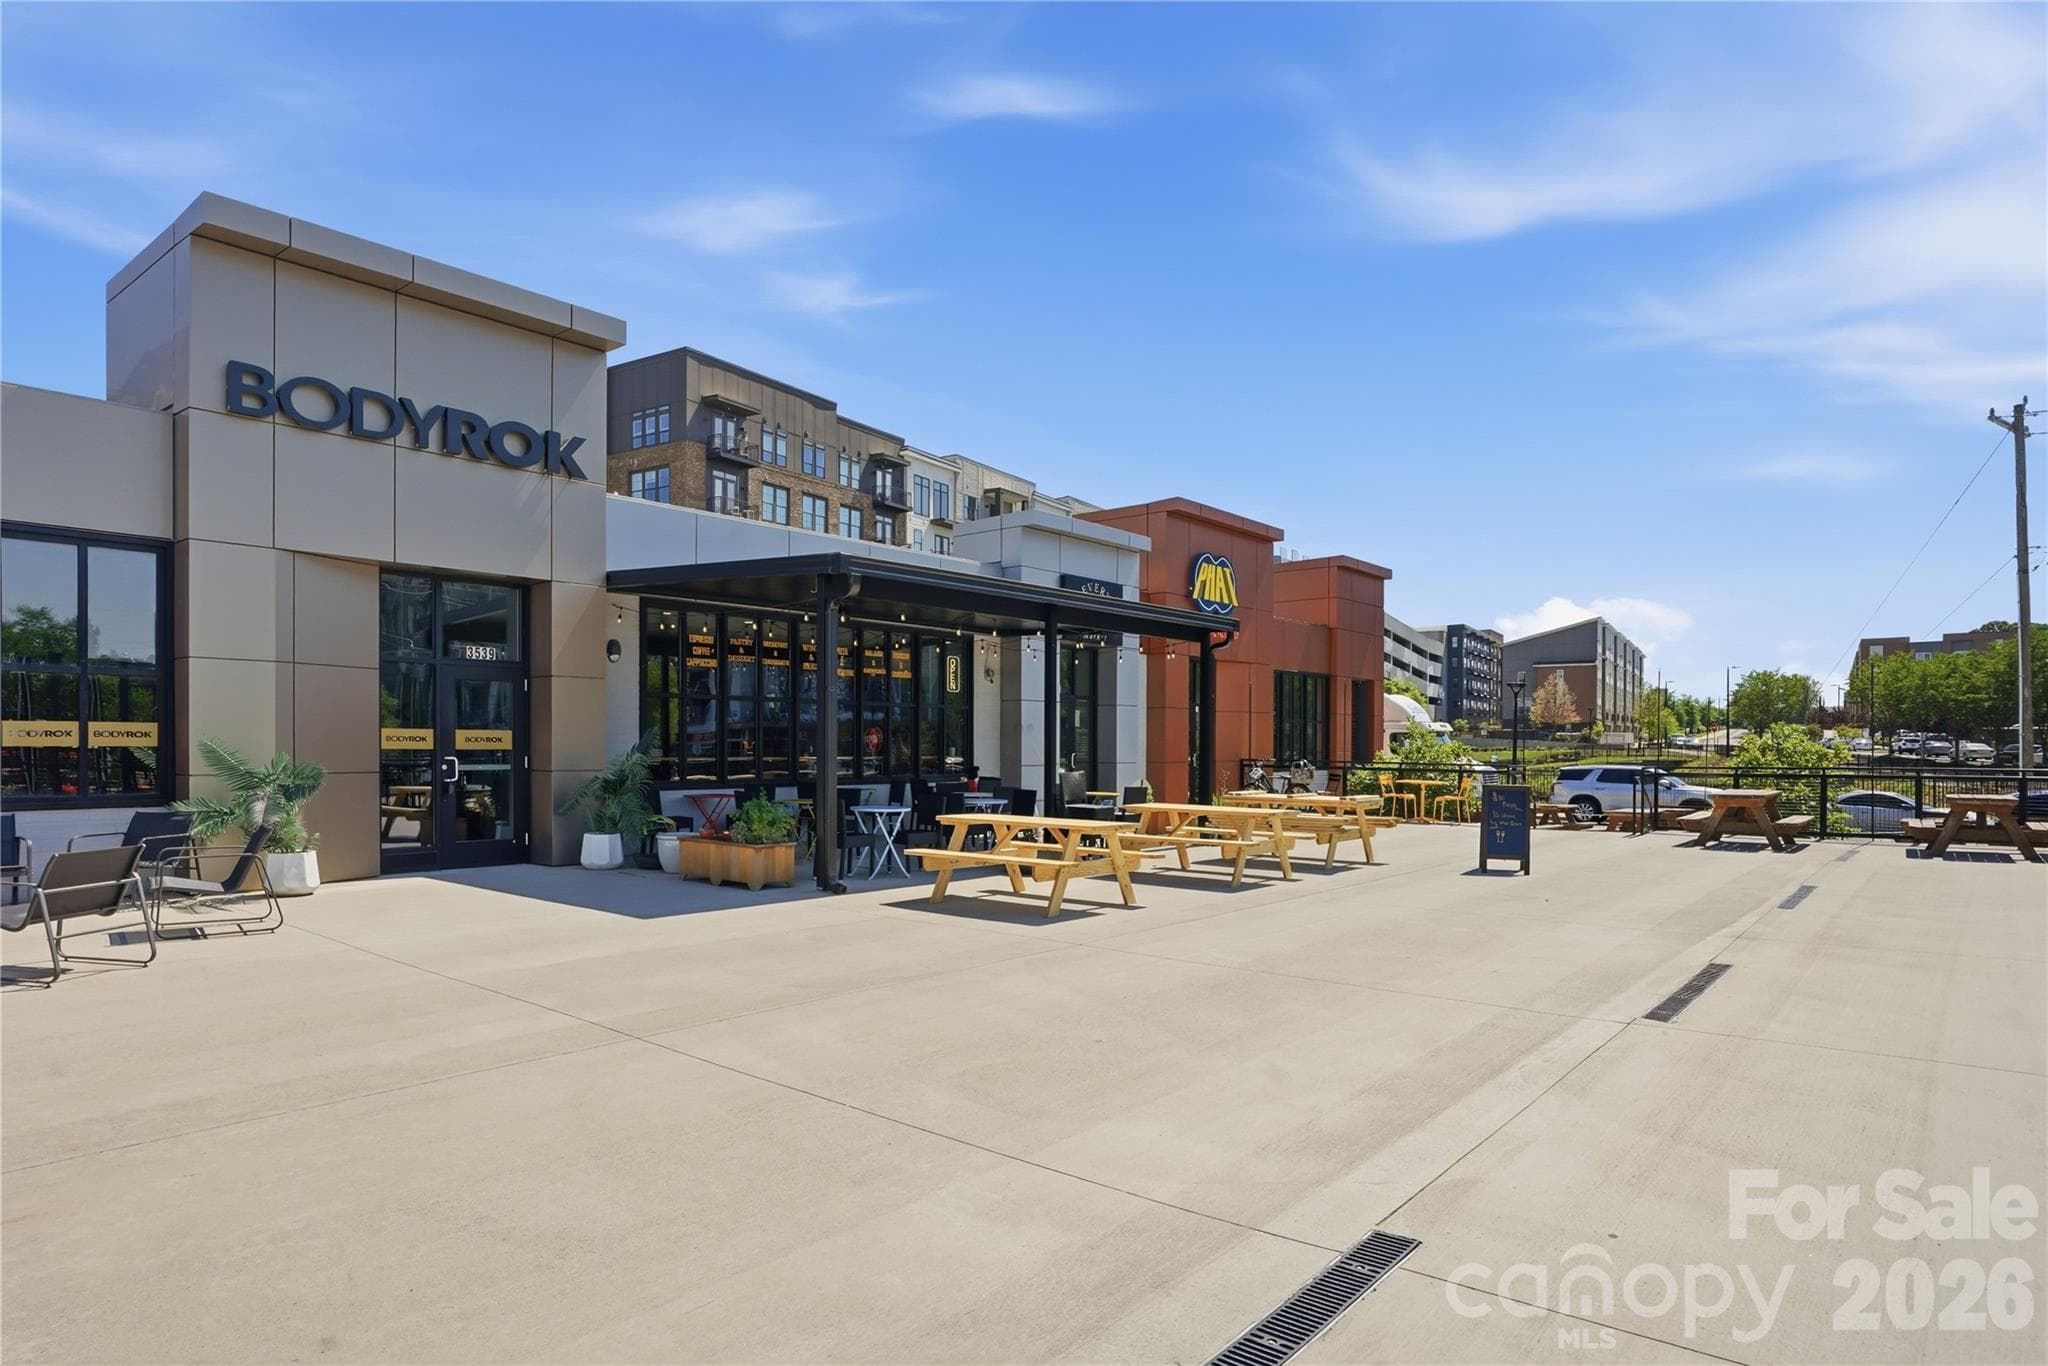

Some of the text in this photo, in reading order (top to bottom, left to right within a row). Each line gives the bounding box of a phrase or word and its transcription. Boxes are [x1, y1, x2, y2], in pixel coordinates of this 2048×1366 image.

[225, 360, 588, 480] BODYROK
[1081, 582, 1110, 597] EVER
[1192, 562, 1239, 607] PHAT
[729, 638, 754, 646] PASTRY
[466, 646, 496, 660] 3539
[692, 646, 711, 656] COFFEE
[728, 654, 756, 663] DESSERT
[93, 730, 152, 739] BODYROK
[385, 735, 428, 743] BODYROK
